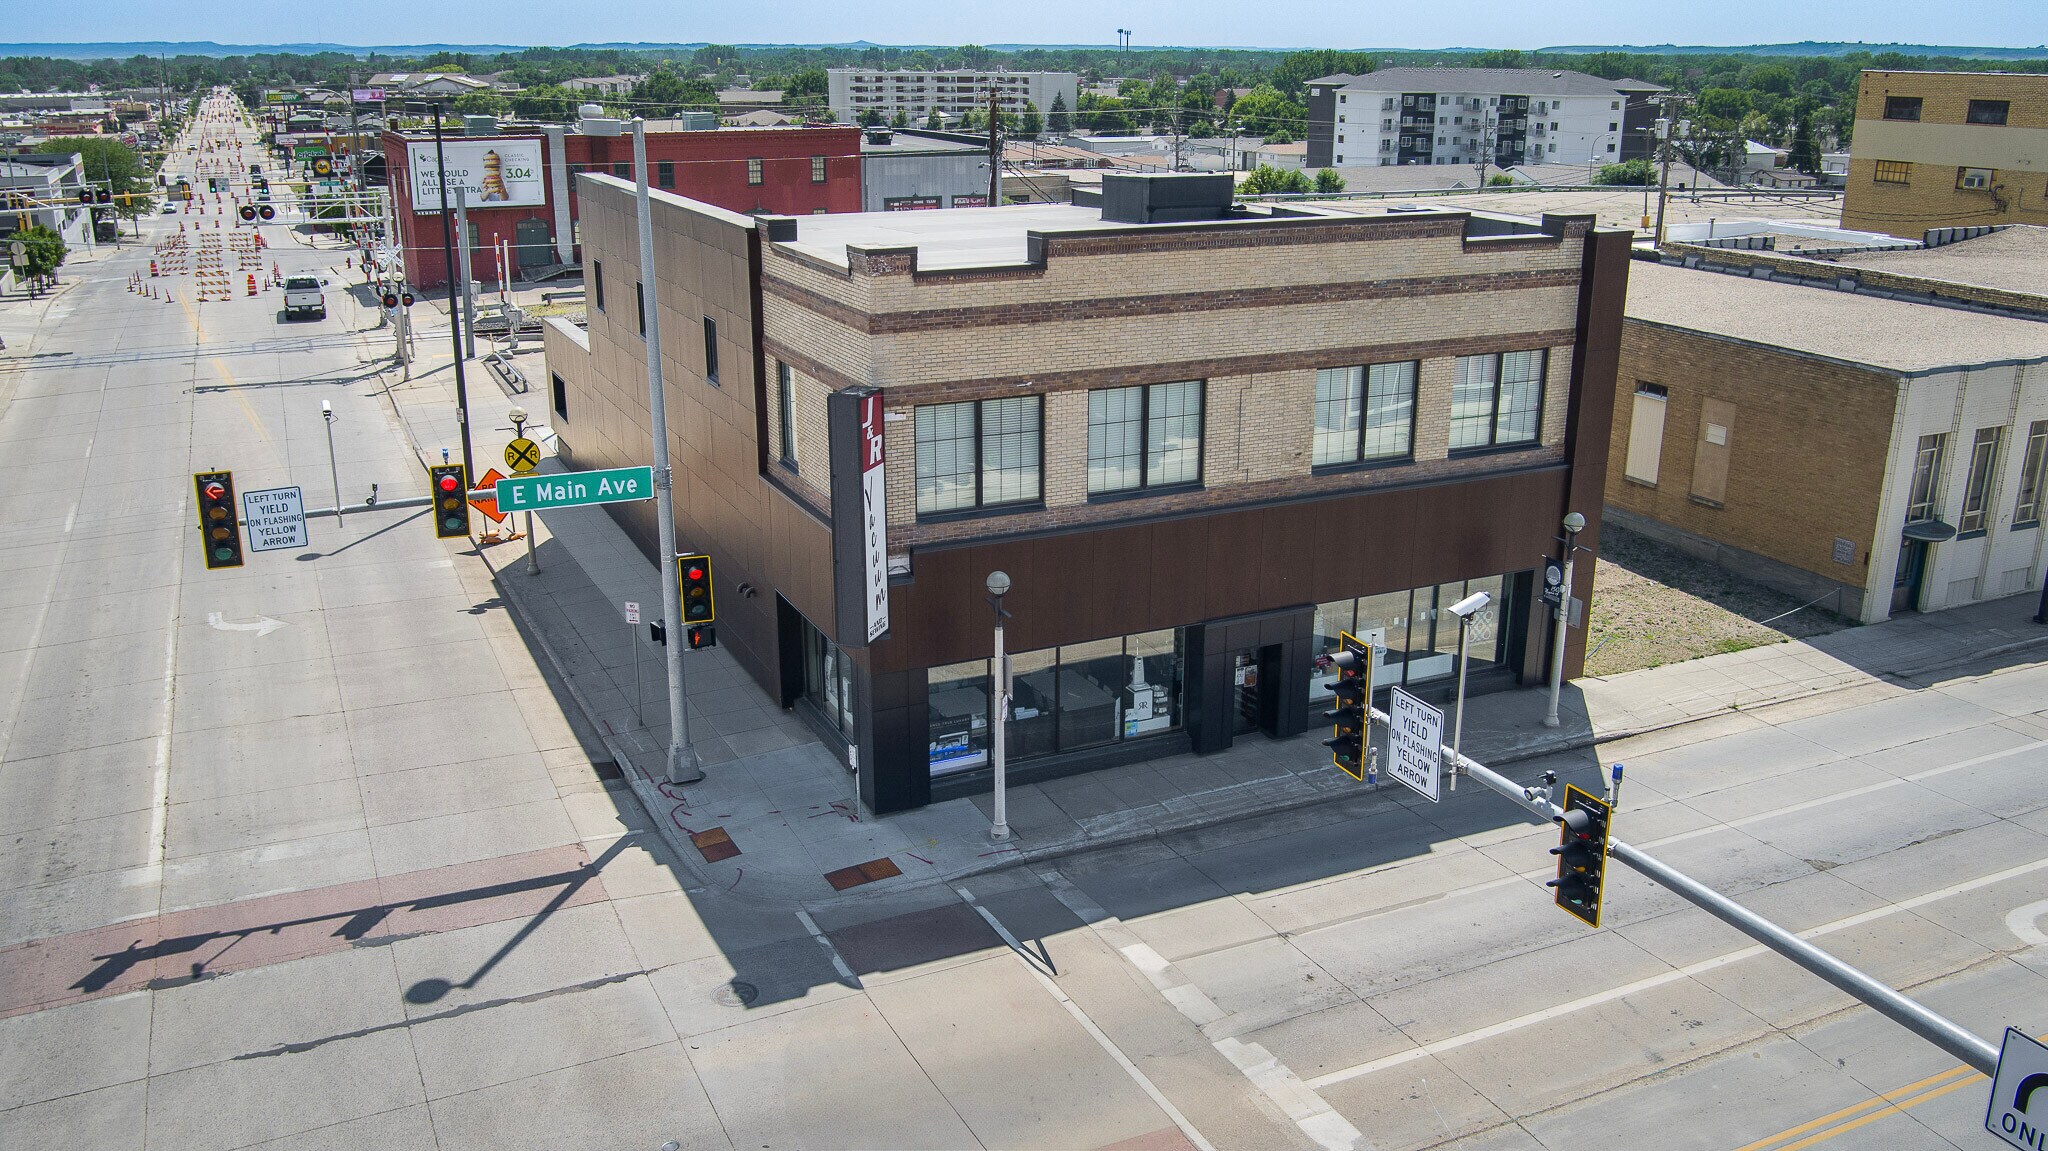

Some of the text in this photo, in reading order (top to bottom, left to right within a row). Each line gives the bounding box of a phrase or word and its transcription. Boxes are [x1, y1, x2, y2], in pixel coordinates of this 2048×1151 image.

[421, 170, 435, 178] WE
[505, 168, 531, 179] 3.04
[422, 187, 452, 195] LITTE
[508, 450, 537, 460] R R
[513, 477, 638, 504] E Main Ave
[248, 491, 297, 504] LEFT TURN
[259, 503, 289, 515] YIELD
[250, 513, 302, 527] ON FLASHING
[258, 525, 297, 536] YELLOW
[263, 536, 296, 546] ARROW
[1395, 695, 1438, 727] LEFT TURN
[1403, 715, 1428, 741] YIELD
[1391, 728, 1437, 763] ON FLASHING
[1396, 746, 1431, 774] YELLOW
[1397, 763, 1428, 788] ARROW
